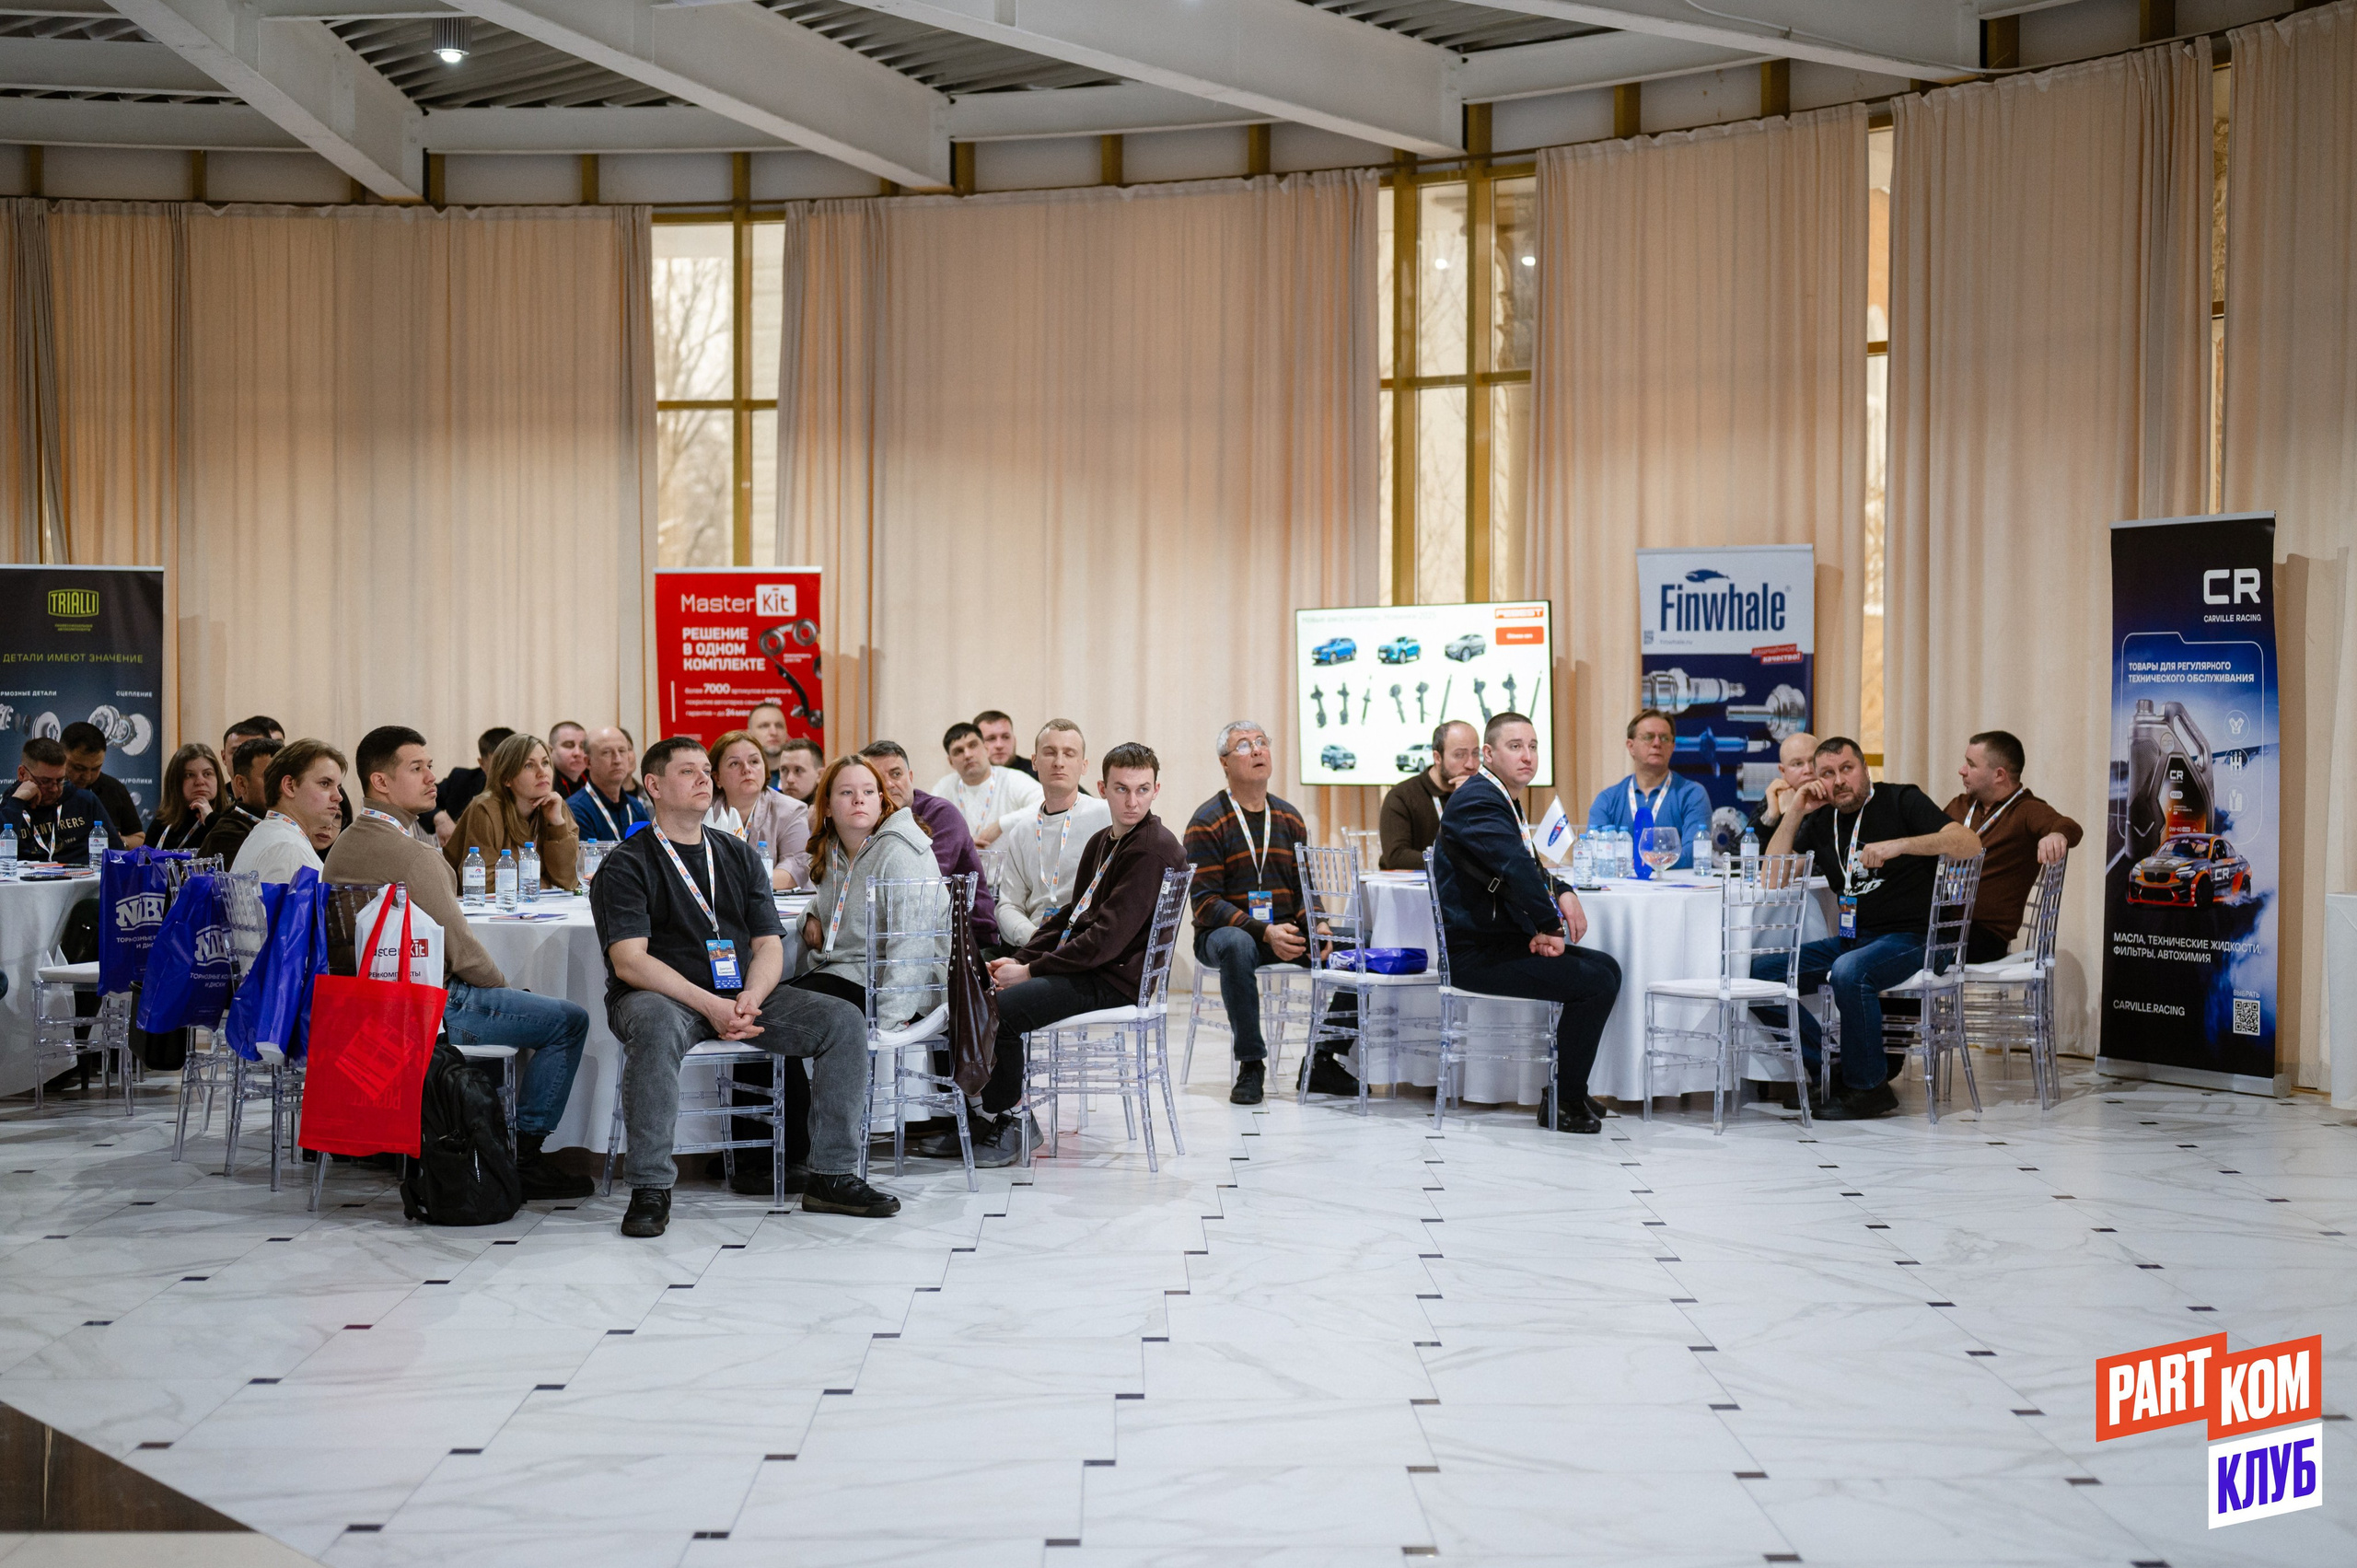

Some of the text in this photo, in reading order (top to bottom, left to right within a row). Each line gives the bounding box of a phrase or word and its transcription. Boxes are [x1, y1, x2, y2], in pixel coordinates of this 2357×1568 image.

[2203, 568, 2260, 605] CR
[51, 592, 96, 614] TRIALLI
[681, 588, 789, 612] Master Kit
[1660, 583, 1786, 631] Finwhale
[2203, 614, 2261, 622] CARVILLE RACING
[682, 627, 749, 640] РЕШЕНИЕ
[683, 643, 746, 657] В ОДНОМ
[3, 653, 144, 663] ДЕТАЛИ ИМЕЮТ ЗНАЧЕНИЕ
[683, 658, 766, 671] КОМПЛЕКТЕ
[2128, 661, 2232, 672] ТОВАРЫ ДЛЯ РЕГУЛЯРНОГО
[2128, 673, 2255, 683] ТЕХНИЧЕСКОГО ОБСЛУЖИВАНИЯ
[703, 683, 731, 694] 7000
[2169, 770, 2183, 780] CR
[2214, 867, 2230, 881] CR
[2113, 932, 2262, 955] МАСЛА, ТЕХНИЧЕСКИЕ ЖИДКОСТИ,
[2113, 946, 2212, 963] ФИЛЬТРЫ, АВТОХИМИЯ
[2233, 989, 2260, 998] ВЫБРАТЬ
[2113, 1000, 2186, 1016] CARVILLE.RACING
